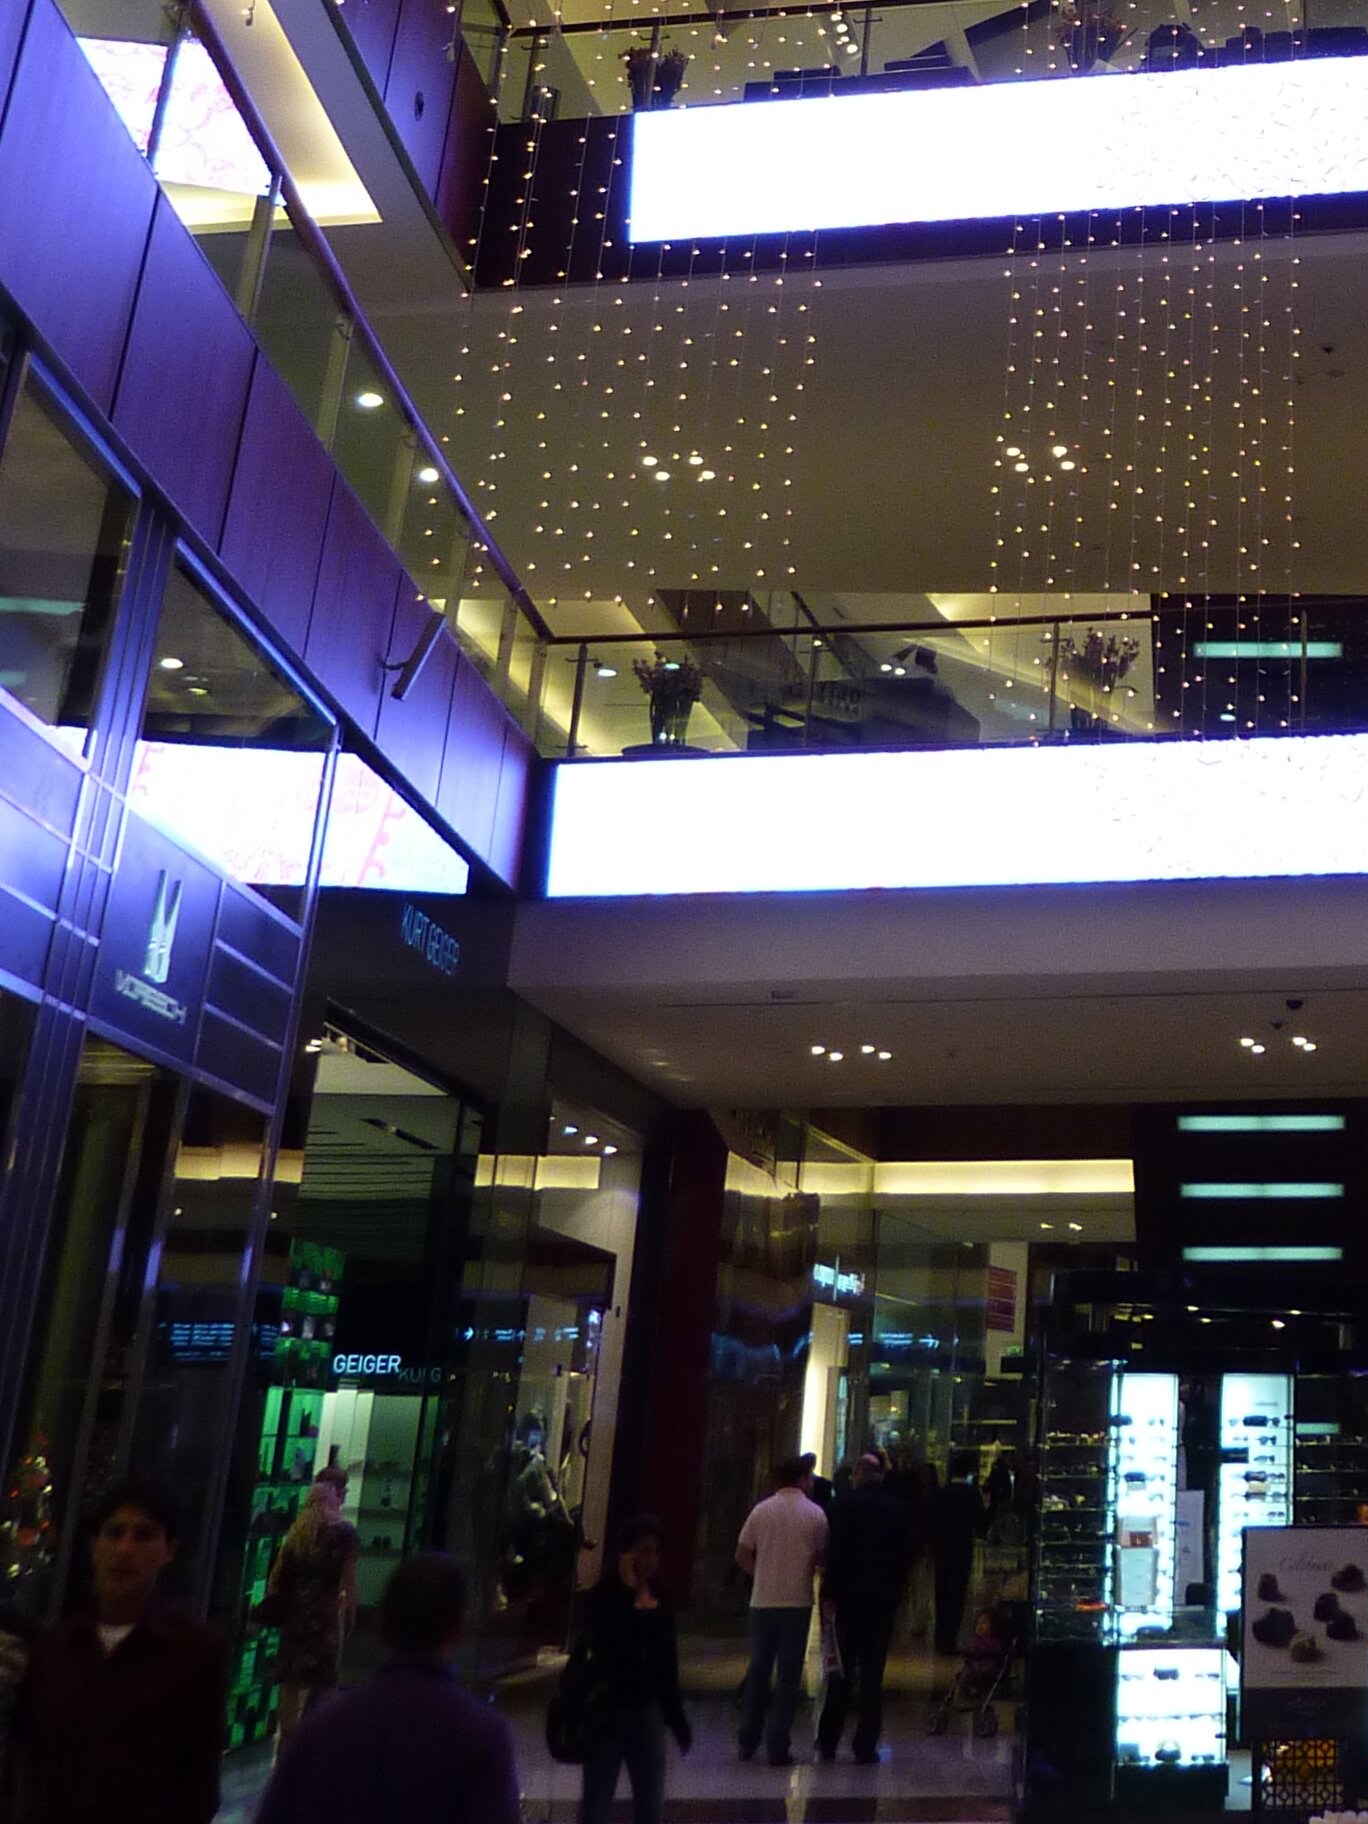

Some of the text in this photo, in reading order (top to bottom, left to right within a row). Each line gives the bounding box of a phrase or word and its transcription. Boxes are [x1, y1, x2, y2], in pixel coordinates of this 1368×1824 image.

[400, 900, 461, 976] KURT GEIGER
[332, 1353, 402, 1375] GEIGER
